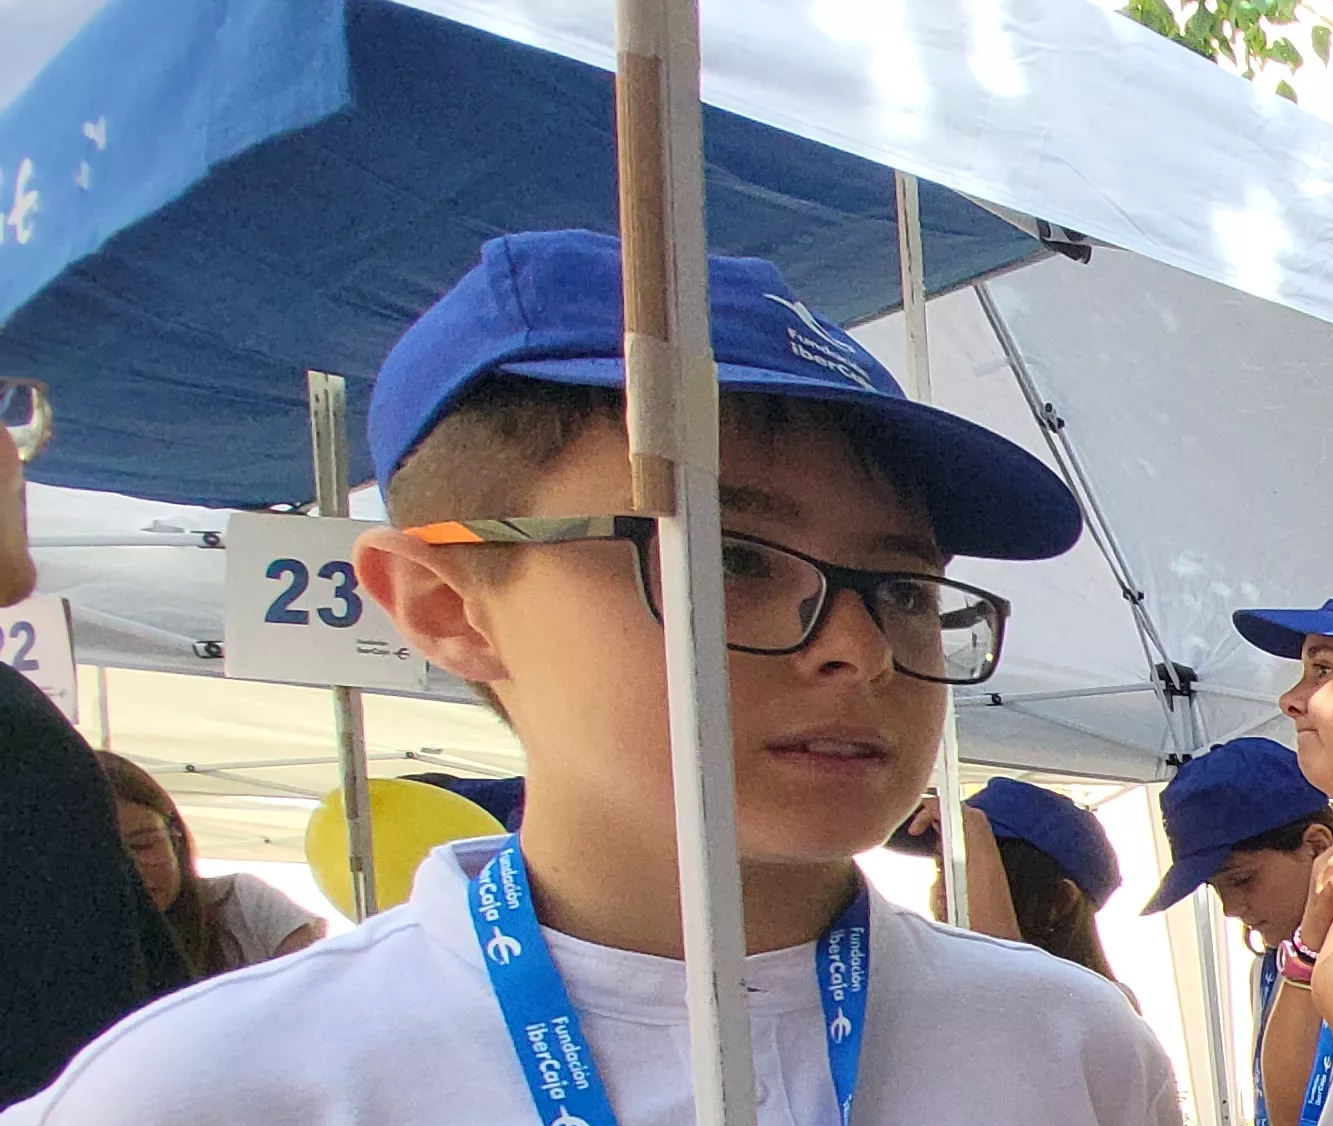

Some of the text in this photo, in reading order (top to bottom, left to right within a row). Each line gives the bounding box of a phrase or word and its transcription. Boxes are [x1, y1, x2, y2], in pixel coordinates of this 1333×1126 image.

[264, 558, 363, 629] 23
[0, 620, 39, 671] 2
[525, 1022, 567, 1101] iberCaja
[552, 1016, 590, 1091] Fundación
